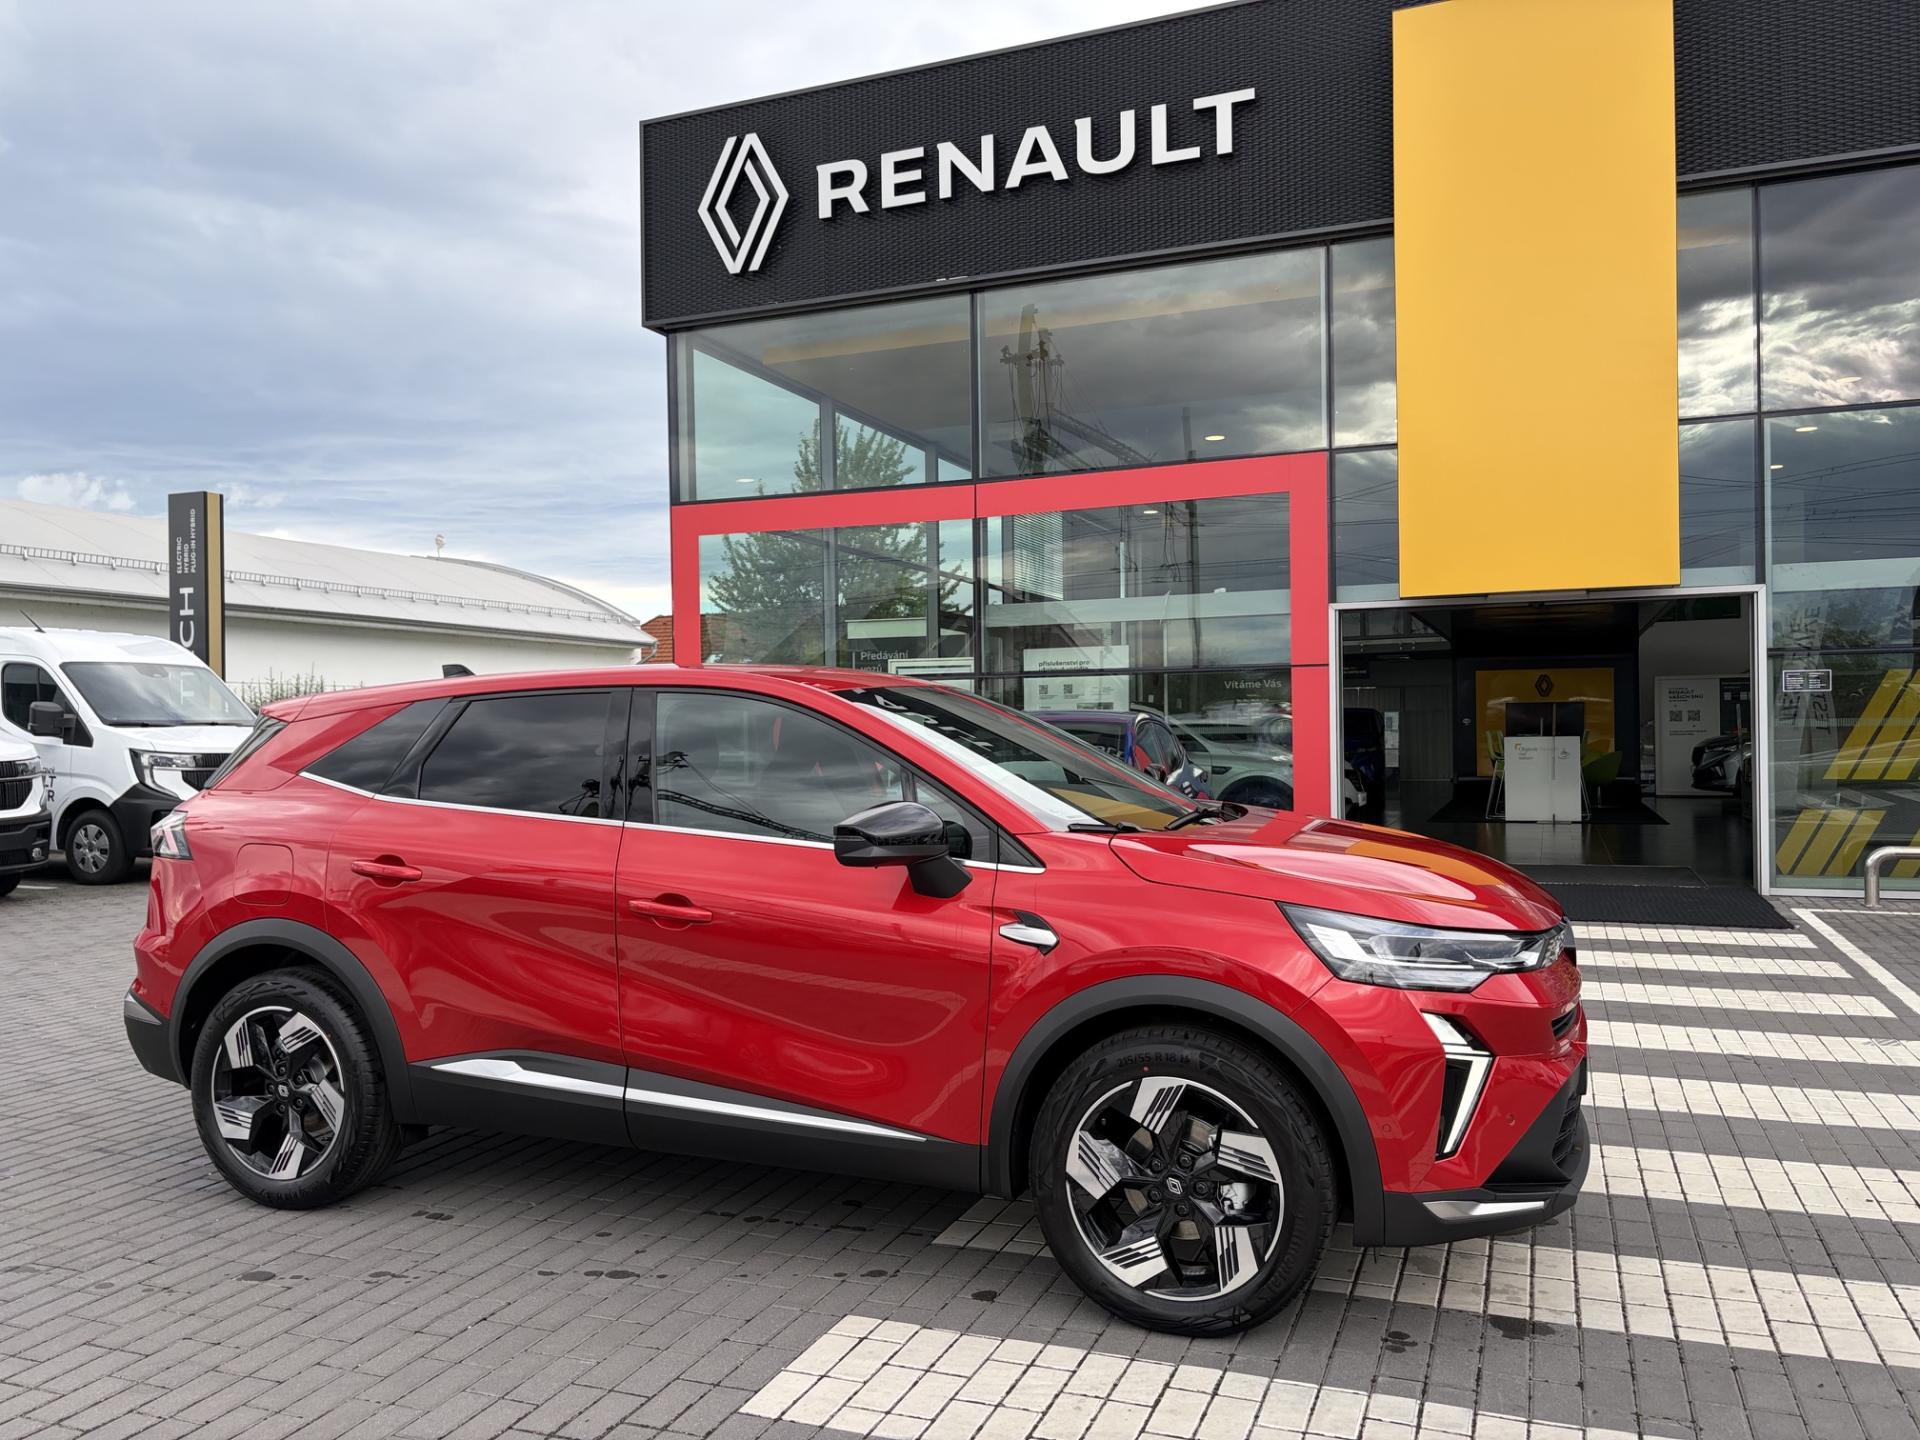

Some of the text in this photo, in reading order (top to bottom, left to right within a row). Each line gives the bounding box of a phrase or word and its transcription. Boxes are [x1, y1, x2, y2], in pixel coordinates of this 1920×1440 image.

[816, 87, 1256, 220] RENAULT
[179, 586, 195, 650] CH
[860, 649, 909, 660] Předávání
[1224, 678, 1282, 689] Vítáme Vás
